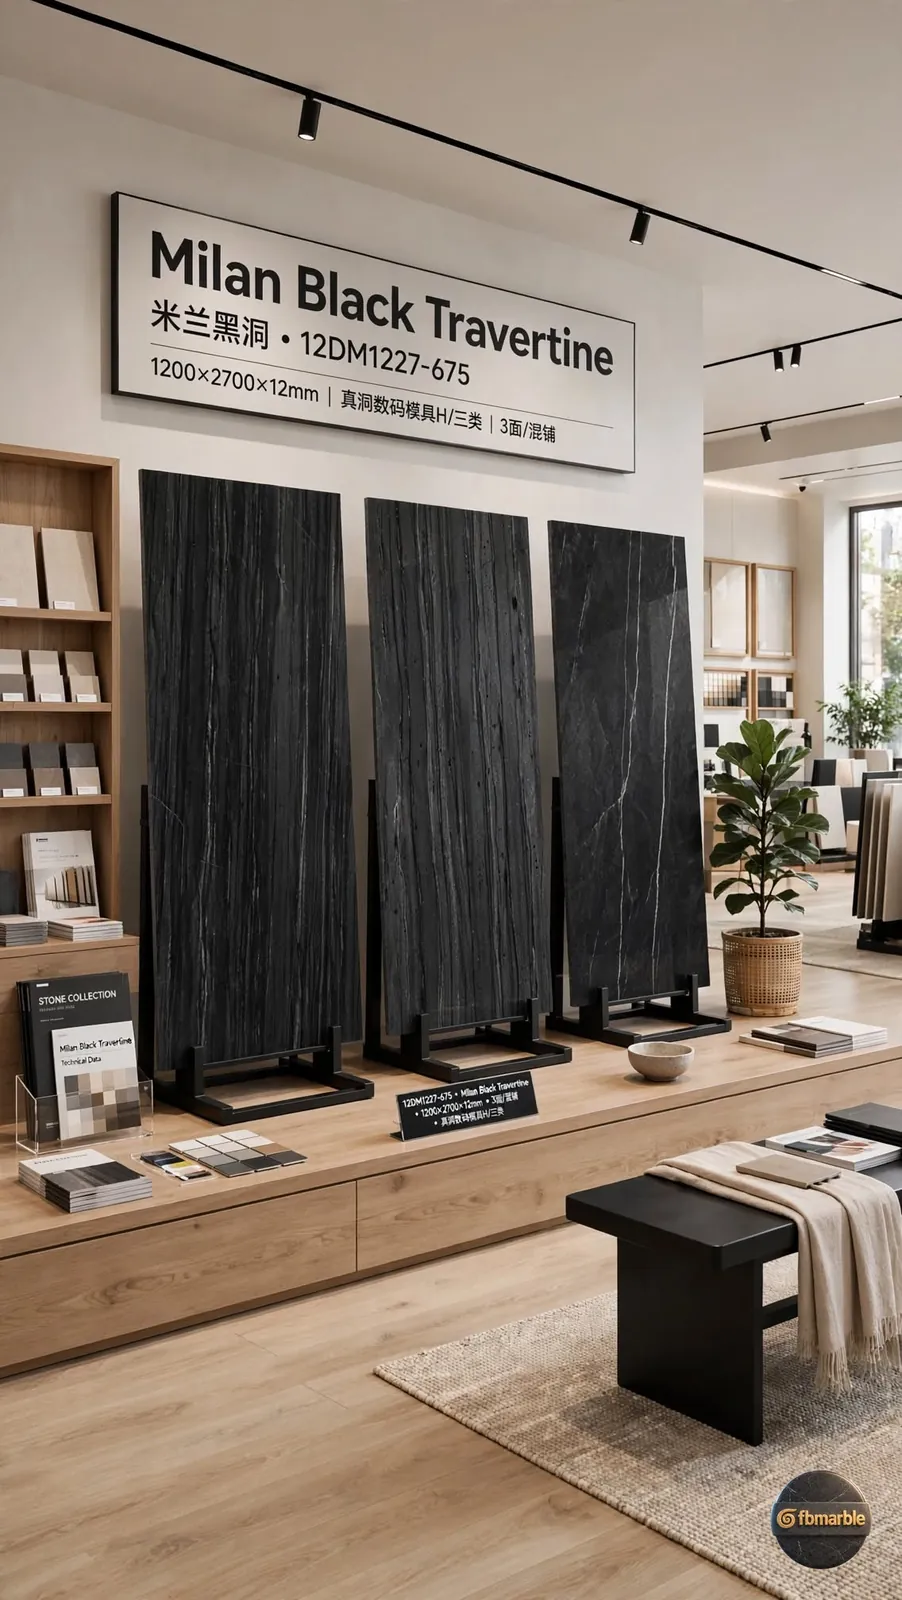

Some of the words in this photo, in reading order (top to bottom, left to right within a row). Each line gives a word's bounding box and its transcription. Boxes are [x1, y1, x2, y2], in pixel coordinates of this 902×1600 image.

[151, 231, 281, 305] Milan
[297, 264, 416, 334] Black
[425, 295, 614, 376] Travertine
[150, 299, 269, 351] 米兰黑洞
[300, 331, 471, 387] 12DM1227-675
[341, 389, 482, 432] 真洞数码模具H/三类
[499, 417, 556, 444] 3面/混铺
[38, 995, 67, 1006] STONE
[67, 990, 117, 1003] COLLECTION
[79, 1041, 97, 1050] Black
[61, 1057, 87, 1066] Technical
[87, 1056, 102, 1064] Data
[402, 1091, 453, 1108] 12DM1227-675
[478, 1083, 497, 1095] Black
